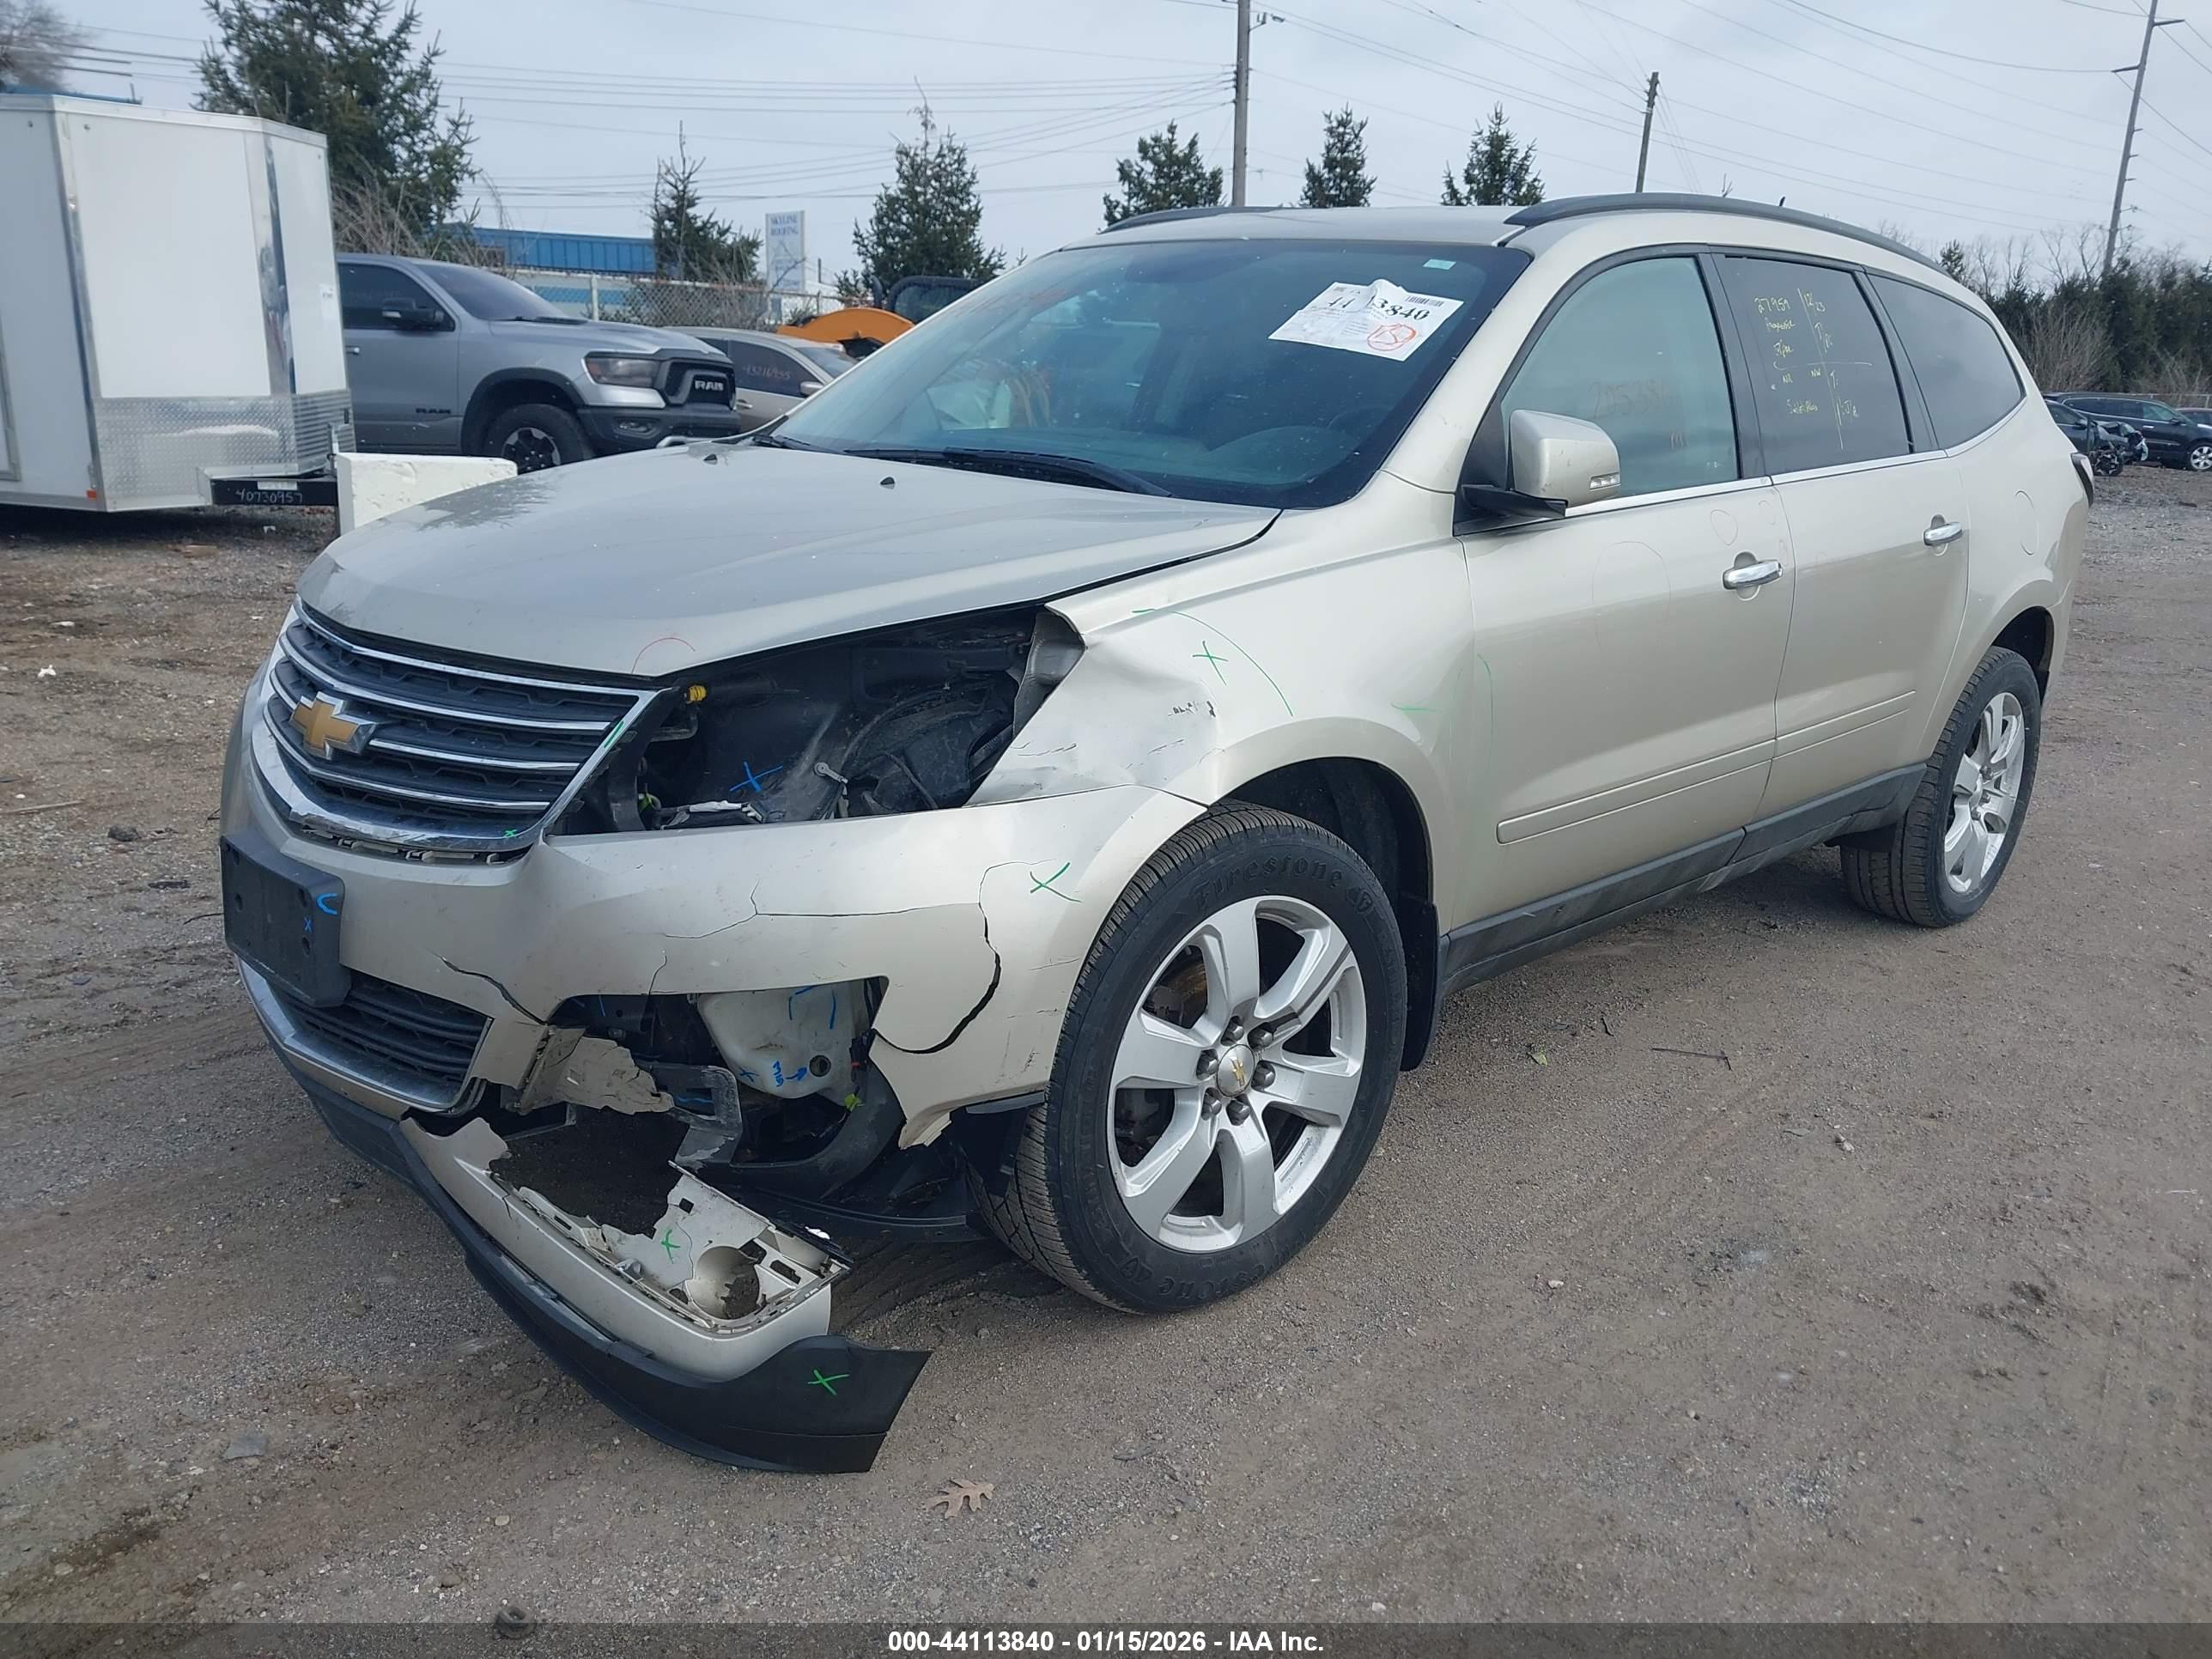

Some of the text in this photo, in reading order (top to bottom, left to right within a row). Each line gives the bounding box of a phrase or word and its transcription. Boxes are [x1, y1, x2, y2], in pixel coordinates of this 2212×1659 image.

[694, 380, 725, 392] RAM
[235, 488, 303, 504] 40730957
[1192, 851, 1344, 913] Firestone
